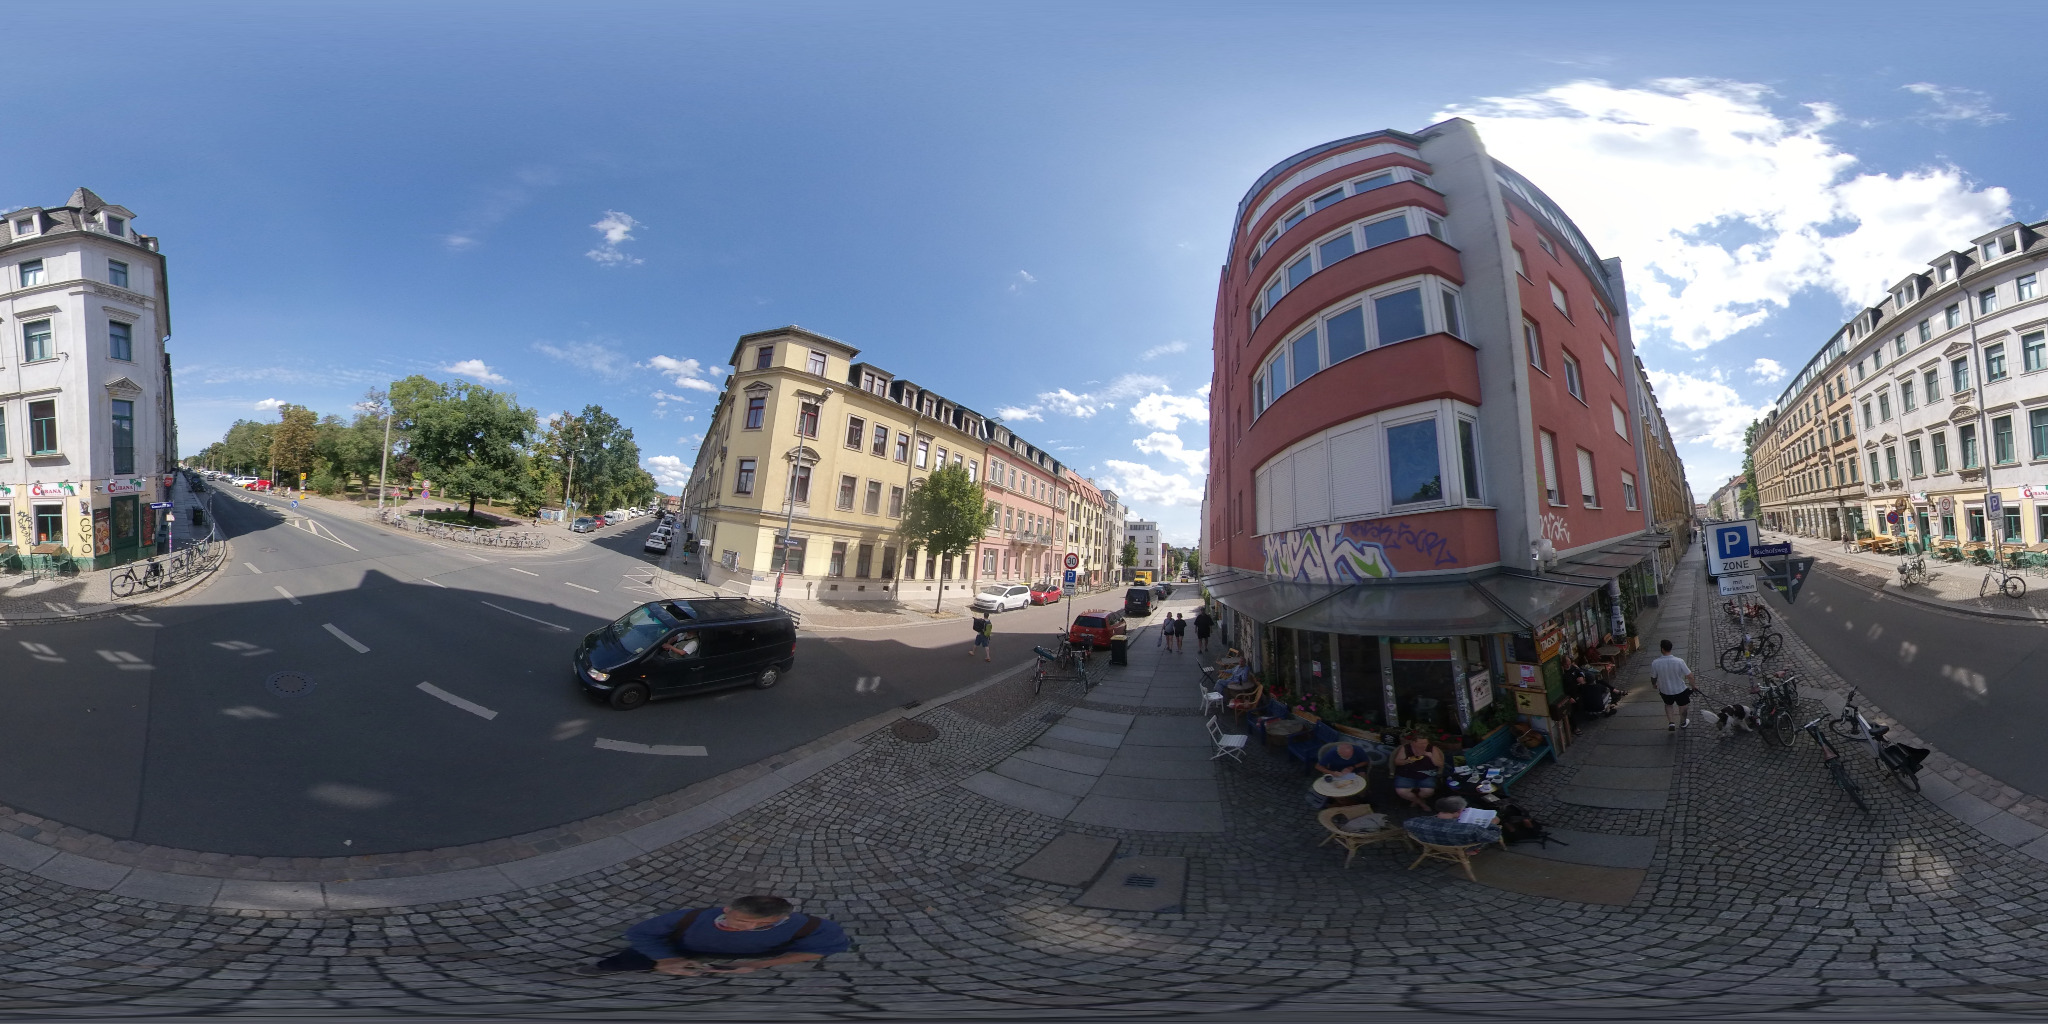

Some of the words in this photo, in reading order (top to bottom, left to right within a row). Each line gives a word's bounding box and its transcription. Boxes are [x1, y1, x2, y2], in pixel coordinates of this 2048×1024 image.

[1724, 531, 1740, 554] P
[1753, 547, 1788, 555] Bischofsweg
[1067, 557, 1076, 566] 30
[1722, 559, 1750, 571] ZONE
[1067, 571, 1074, 581] P
[1722, 583, 1755, 593] Parkschein
